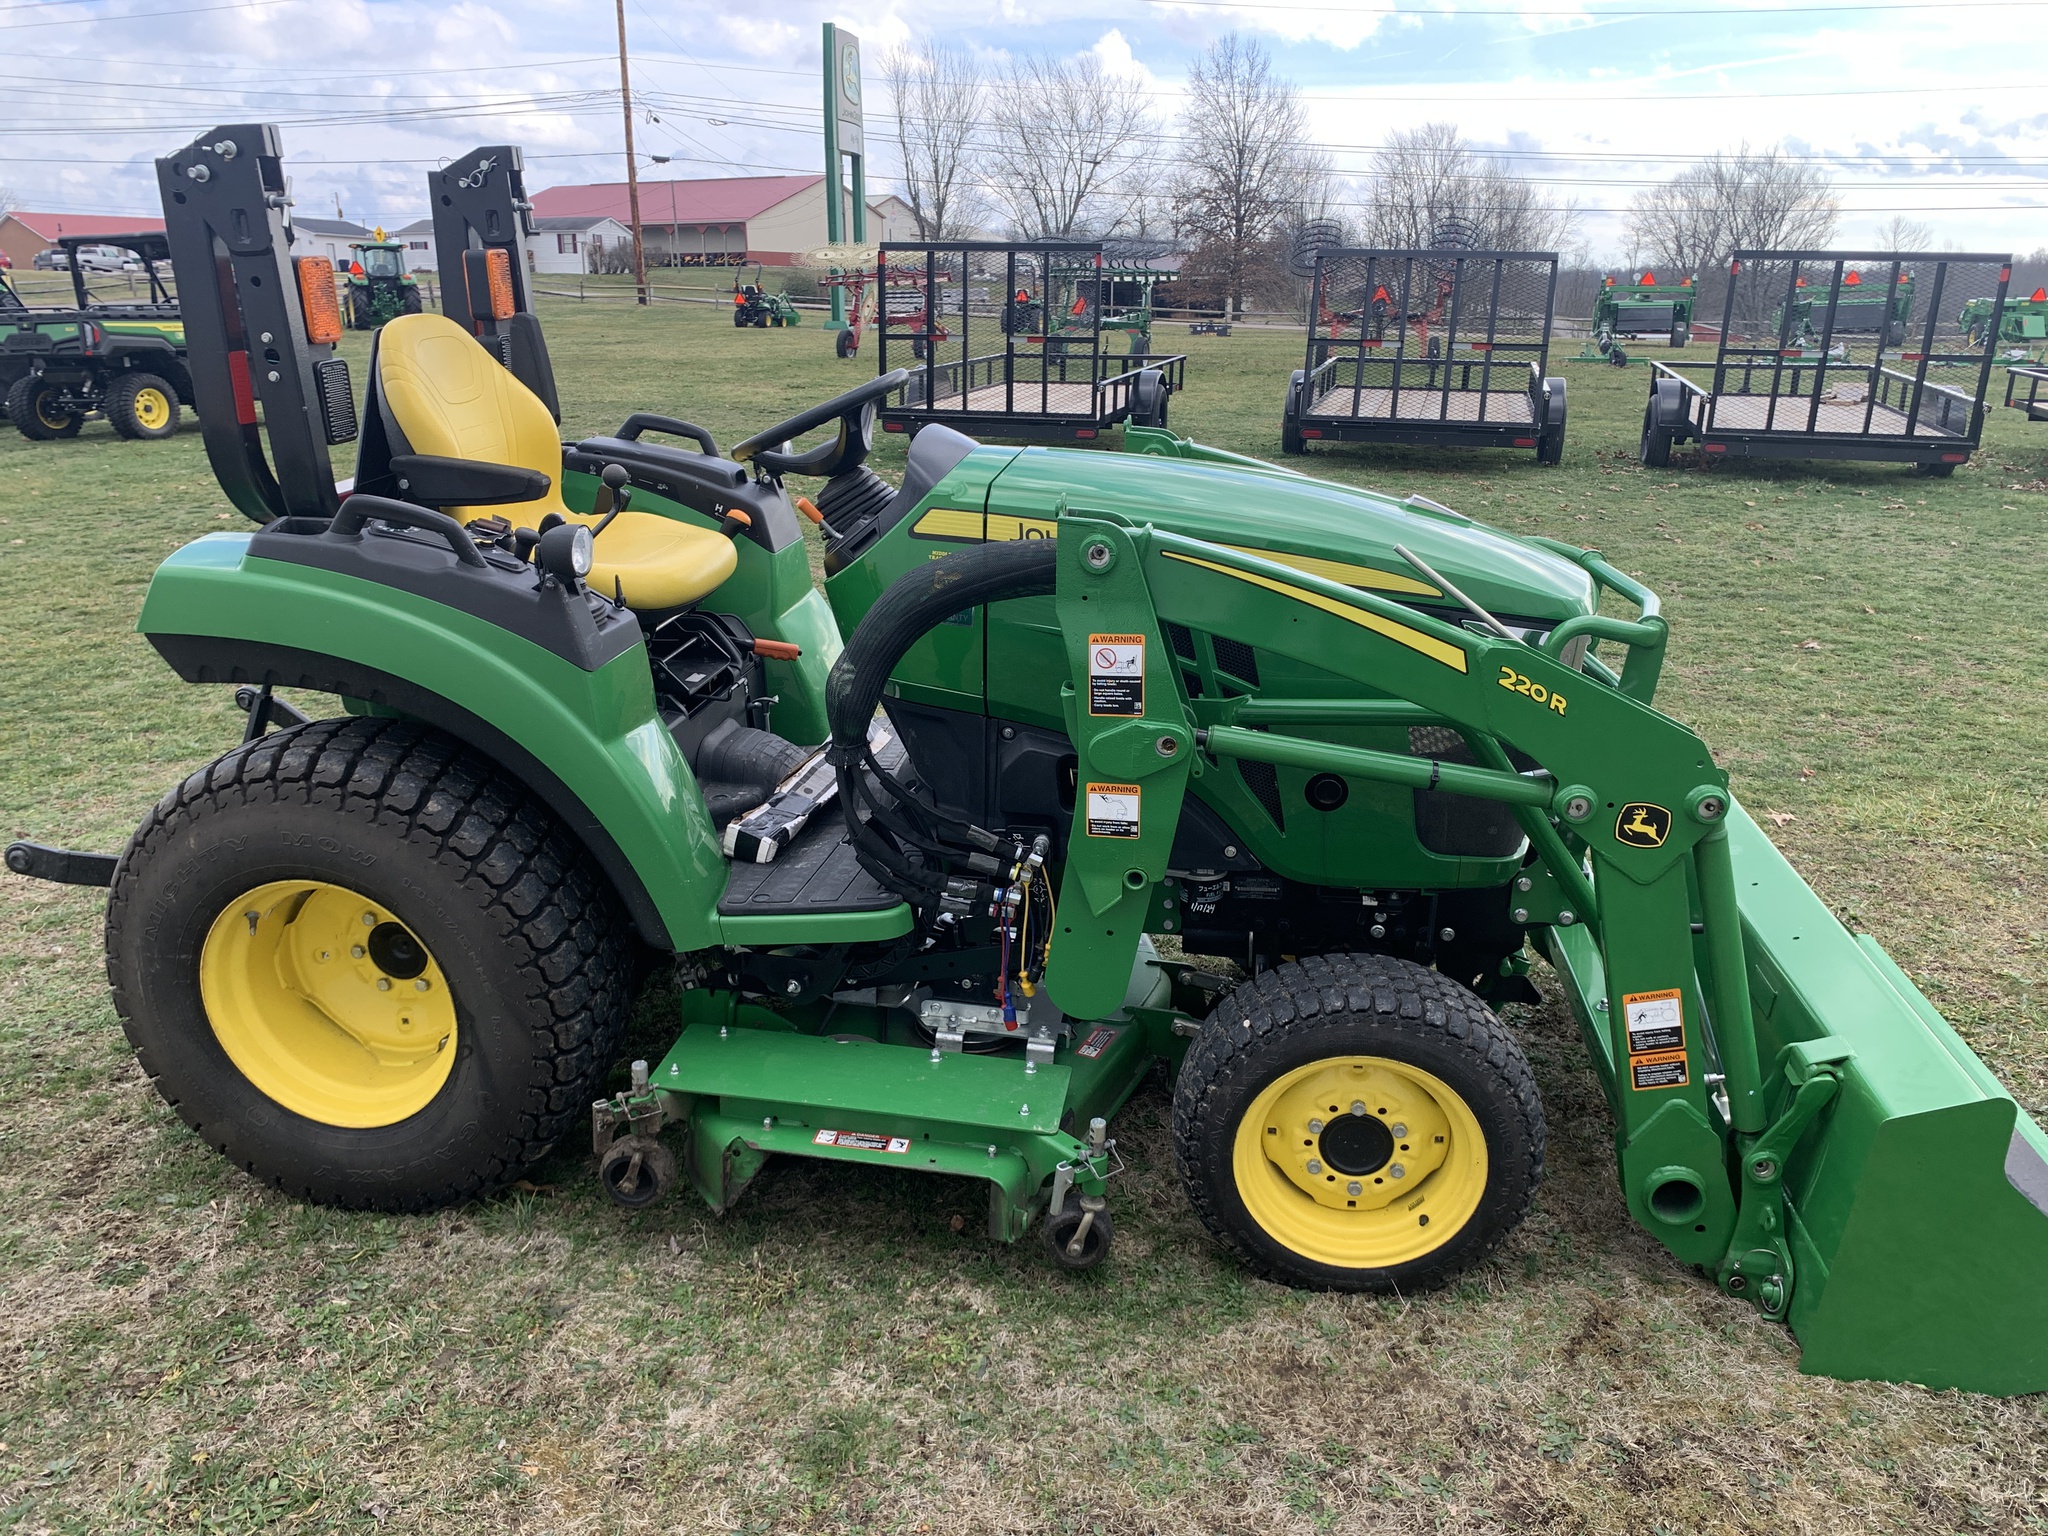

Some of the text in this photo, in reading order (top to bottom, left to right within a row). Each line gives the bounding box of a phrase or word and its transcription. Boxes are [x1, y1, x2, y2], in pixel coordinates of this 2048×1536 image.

[714, 503, 723, 513] H
[144, 830, 378, 942] MIGHTY MOW
[1639, 992, 1674, 1000] WARNING
[1646, 1054, 1680, 1063] WARNING
